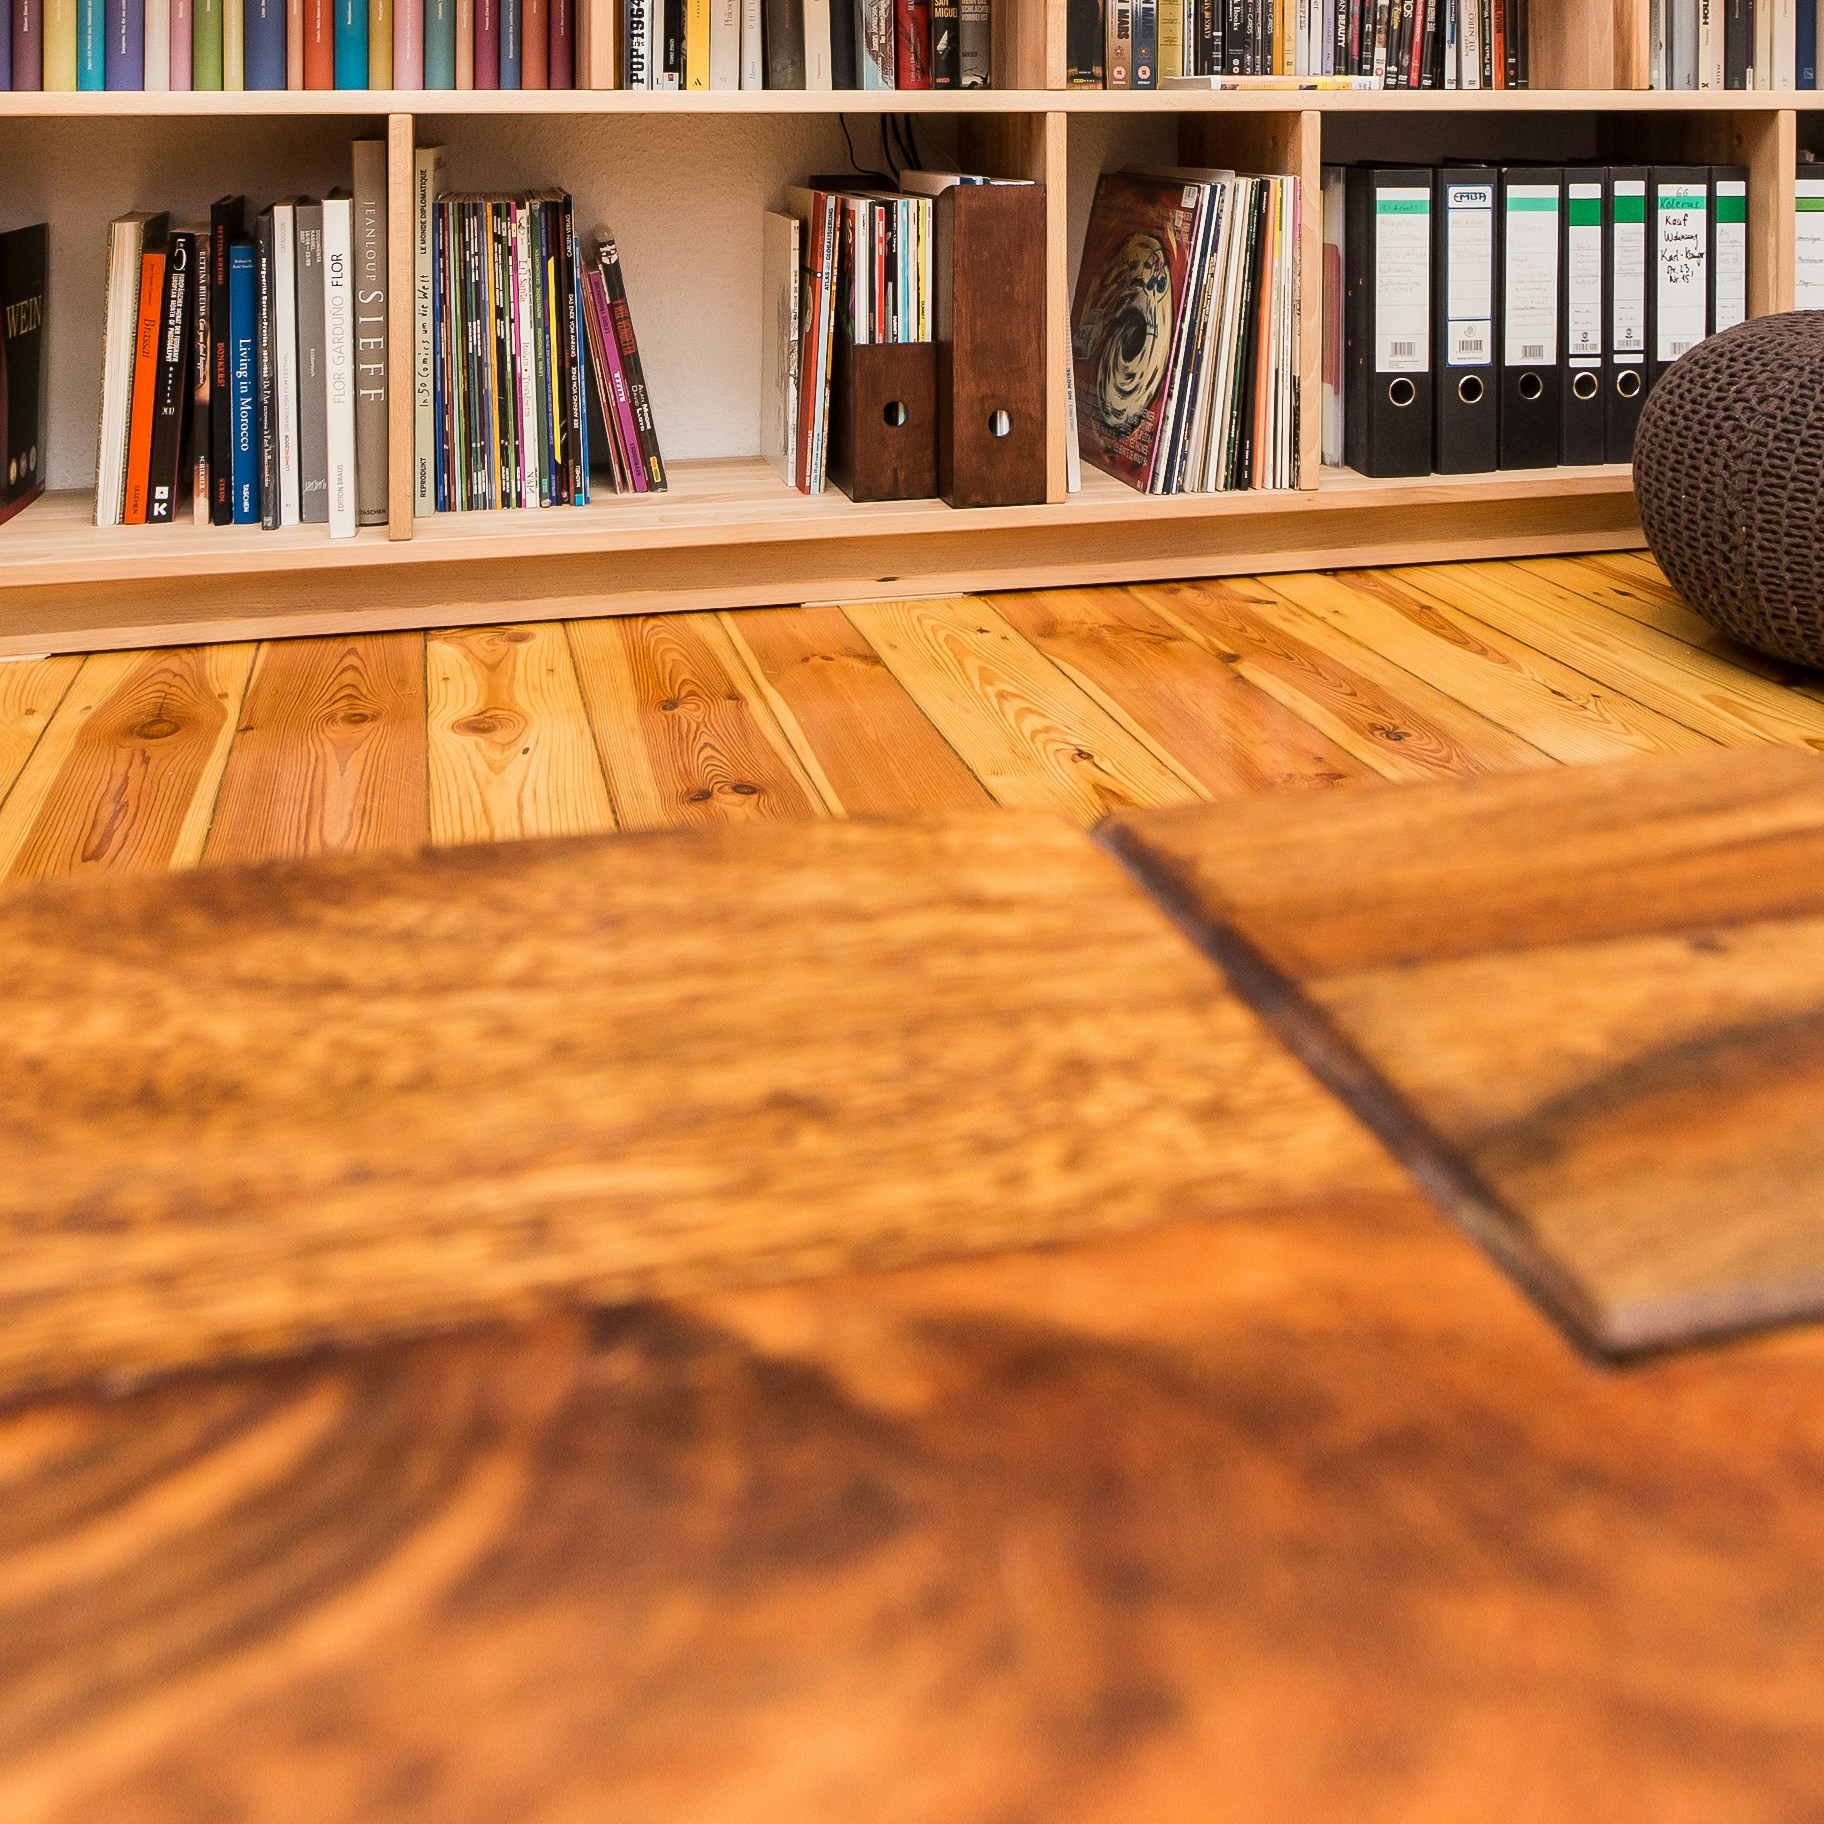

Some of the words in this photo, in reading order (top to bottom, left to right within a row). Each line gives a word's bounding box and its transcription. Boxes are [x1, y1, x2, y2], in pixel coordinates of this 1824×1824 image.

[1116, 8, 1130, 40] MARS
[1141, 6, 1153, 40] MARS
[1232, 6, 1241, 31] Books
[1337, 14, 1346, 48] BEAUTY
[1392, 5, 1402, 30] Fiction
[1467, 12, 1476, 38] NIRO
[1468, 40, 1477, 52] DI
[419, 169, 428, 220] DIPLOMATIQUE
[1454, 192, 1487, 204] EMBA
[419, 220, 427, 244] MONDE
[1665, 213, 1690, 227] Kauf
[216, 225, 224, 256] BETTINA
[362, 199, 378, 282] JEANLOUP
[419, 244, 427, 255] LE
[565, 234, 573, 257] CARLSEN
[329, 253, 344, 287] FLOR
[417, 274, 429, 300] Welt
[6, 294, 43, 339] WEIN
[328, 294, 346, 366] GARDUÑO
[236, 338, 252, 378] Living
[357, 289, 385, 403] SIEFF
[418, 339, 431, 377] Comics
[216, 342, 226, 387] BONKERS!
[239, 380, 250, 394] in
[331, 371, 346, 404] FLOR
[417, 382, 429, 396] 50
[419, 397, 430, 408] In
[239, 396, 251, 452] Morocco
[336, 463, 344, 485] BRAUS
[419, 457, 427, 498] REPRODUKT
[132, 484, 141, 515] TASCHEN
[218, 477, 226, 504] STEIDL
[242, 483, 250, 513] TASCHEN
[336, 486, 345, 512] EDITION
